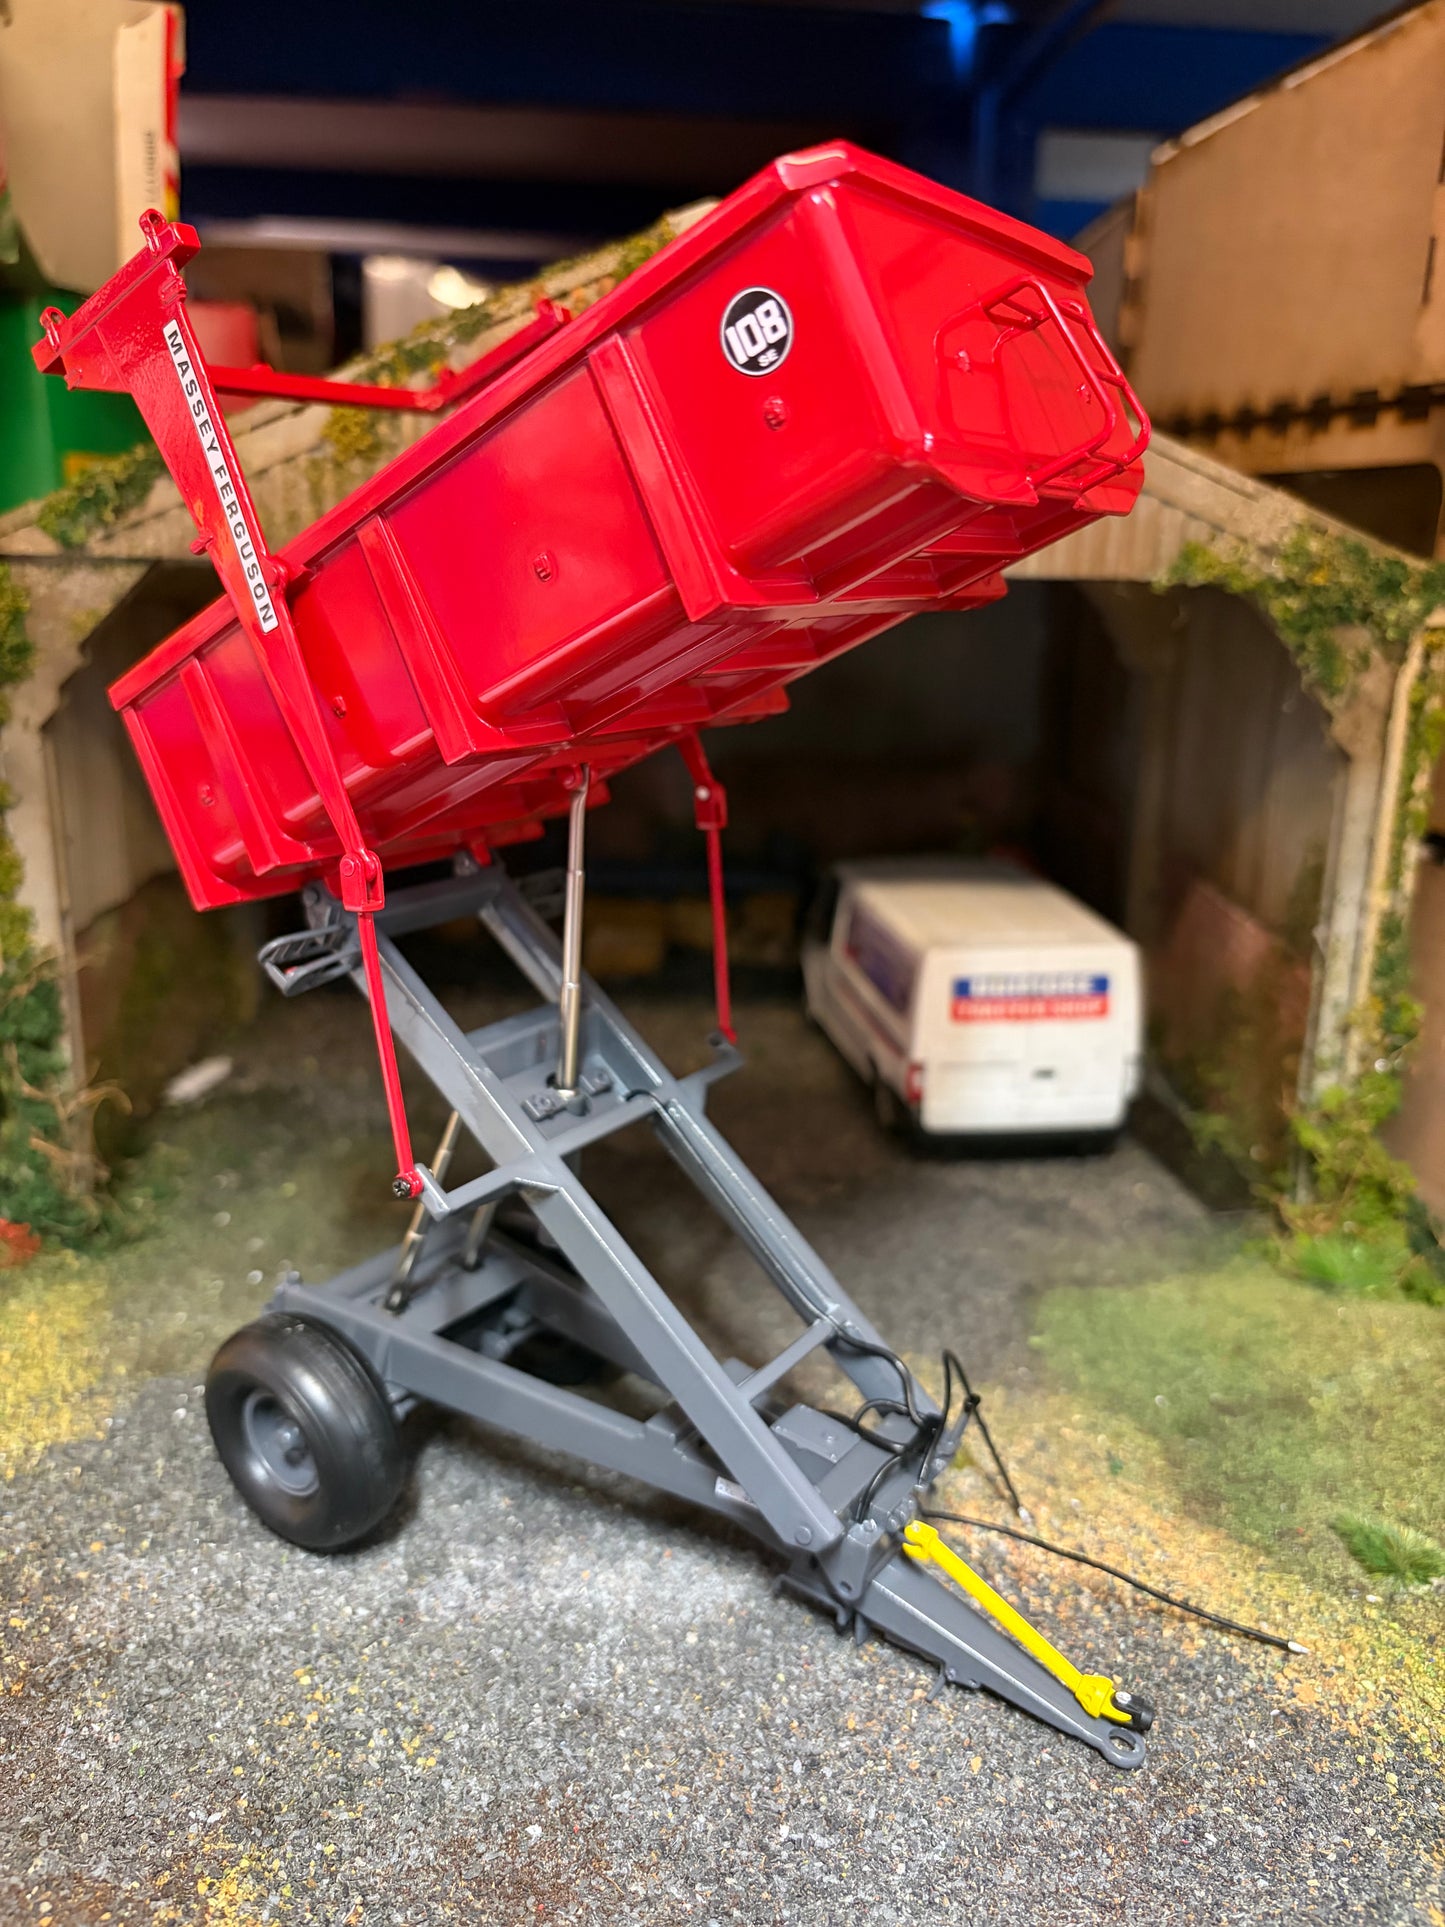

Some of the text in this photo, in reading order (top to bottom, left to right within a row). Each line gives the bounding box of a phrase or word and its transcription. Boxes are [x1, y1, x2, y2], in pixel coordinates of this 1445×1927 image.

[725, 299, 788, 365] 108
[757, 348, 779, 367] SE
[167, 329, 274, 624] MASSEY FERGUSON
